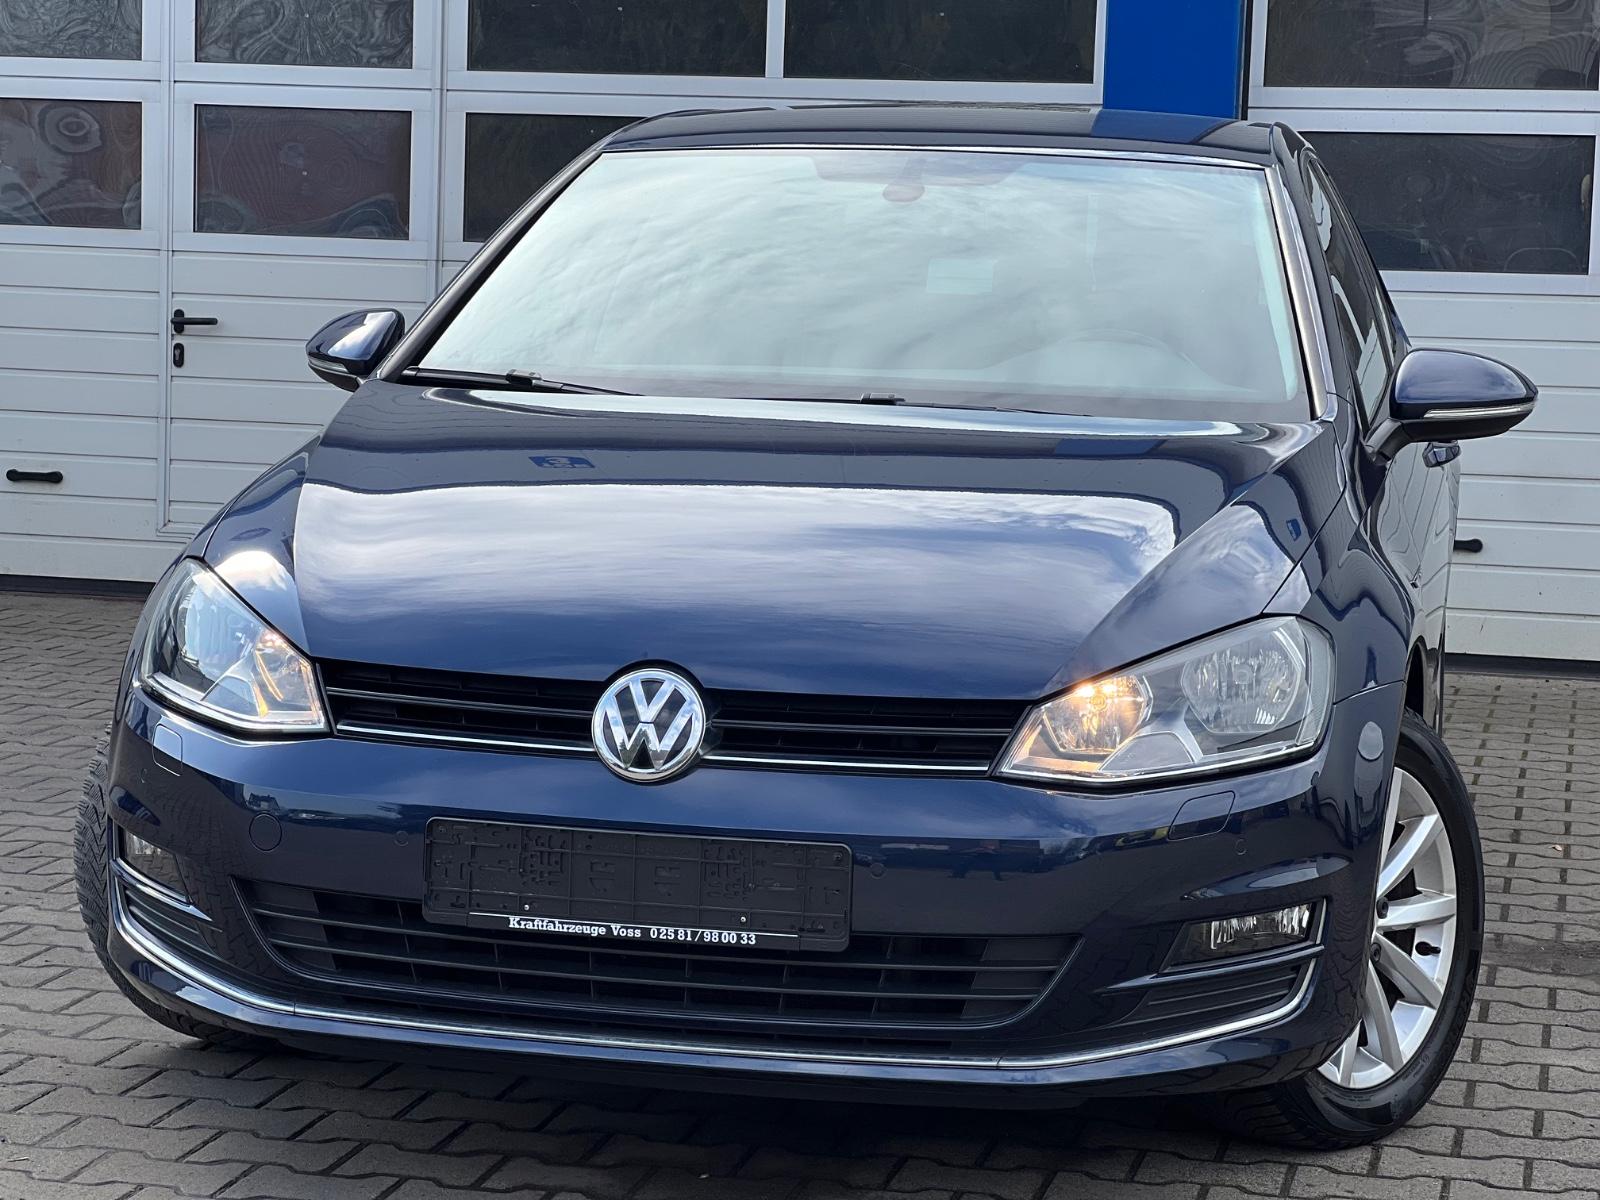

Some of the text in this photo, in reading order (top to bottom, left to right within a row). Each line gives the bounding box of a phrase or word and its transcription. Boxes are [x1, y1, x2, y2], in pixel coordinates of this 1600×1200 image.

[593, 669, 705, 782] VW
[508, 917, 607, 936] Kraftfahrzeuge
[611, 924, 642, 938] Voss
